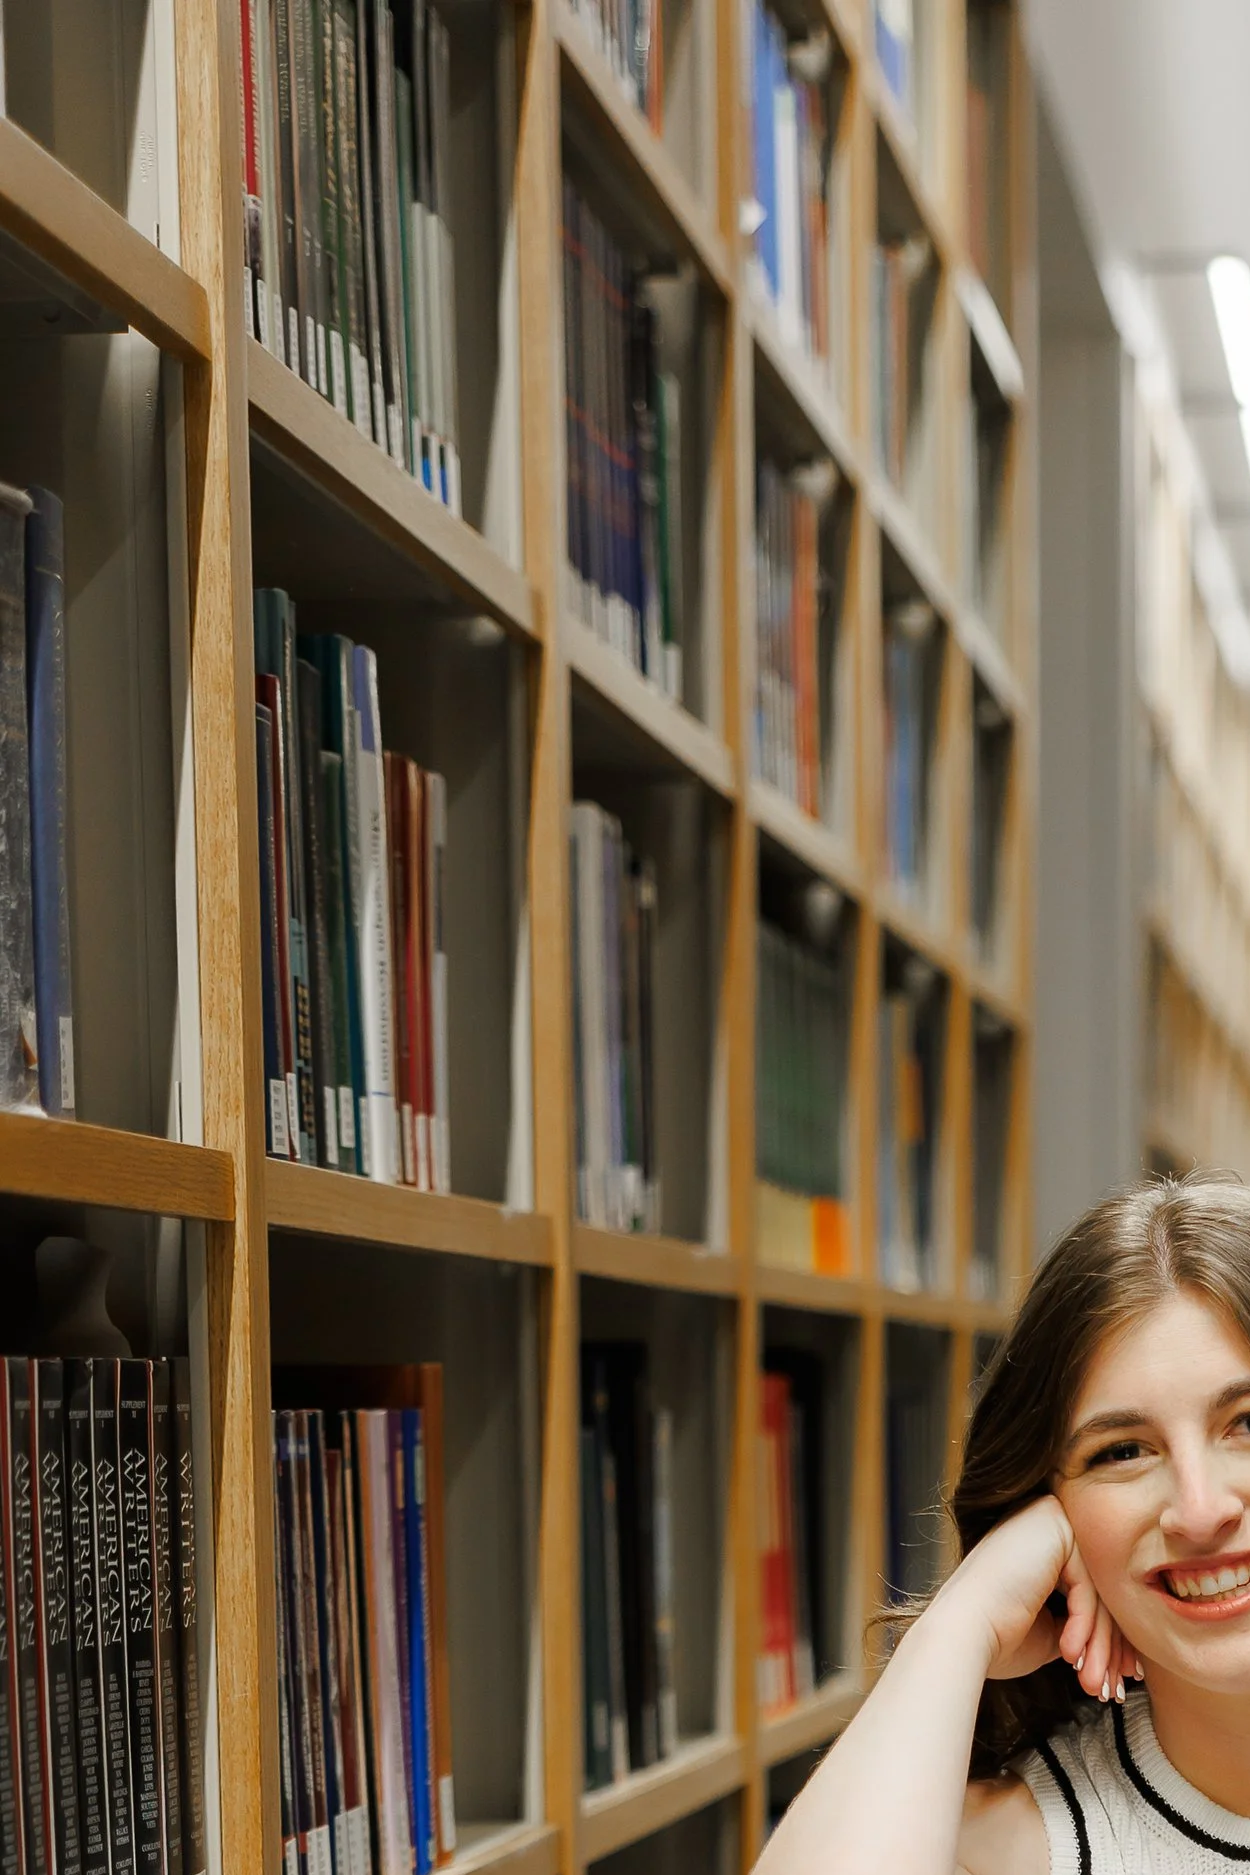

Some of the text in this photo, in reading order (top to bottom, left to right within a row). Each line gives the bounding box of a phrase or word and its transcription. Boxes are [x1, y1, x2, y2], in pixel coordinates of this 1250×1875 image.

[50, 1451, 67, 1640] AMERICAN
[78, 1460, 94, 1648] AMERICAN
[103, 1459, 121, 1643] AMERICAN
[123, 1449, 142, 1633] WRITERS
[135, 1448, 152, 1628] AMERICAN
[159, 1452, 172, 1629] AMERICAN
[180, 1451, 192, 1628] WRITERS
